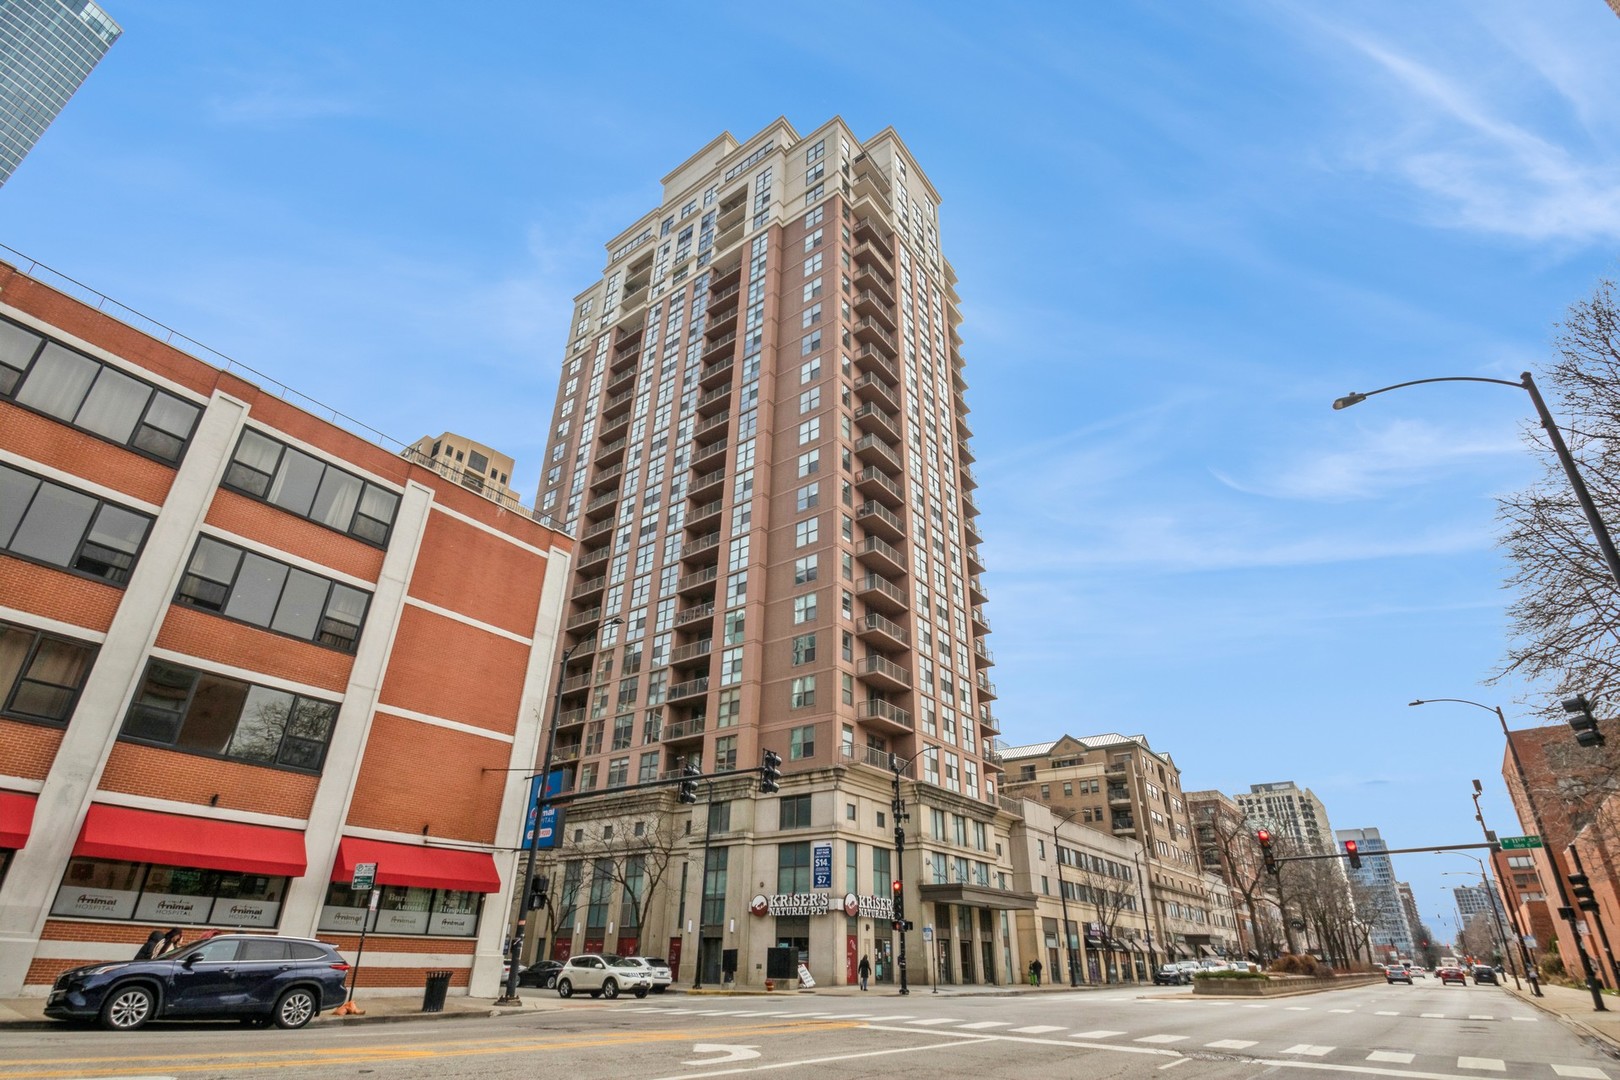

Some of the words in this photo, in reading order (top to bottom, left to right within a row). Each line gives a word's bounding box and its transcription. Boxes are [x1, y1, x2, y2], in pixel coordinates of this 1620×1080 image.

[815, 858, 829, 867] $14
[817, 875, 827, 885] $7
[77, 894, 117, 906] Animal
[157, 900, 194, 911] Animal
[229, 905, 263, 915] Animal
[155, 909, 192, 917] HOSPITAL
[768, 907, 810, 916] NATURAL
[811, 906, 829, 915] PET
[858, 909, 887, 919] NATURAL
[887, 911, 896, 919] PE
[228, 913, 262, 921] HOSPITAL
